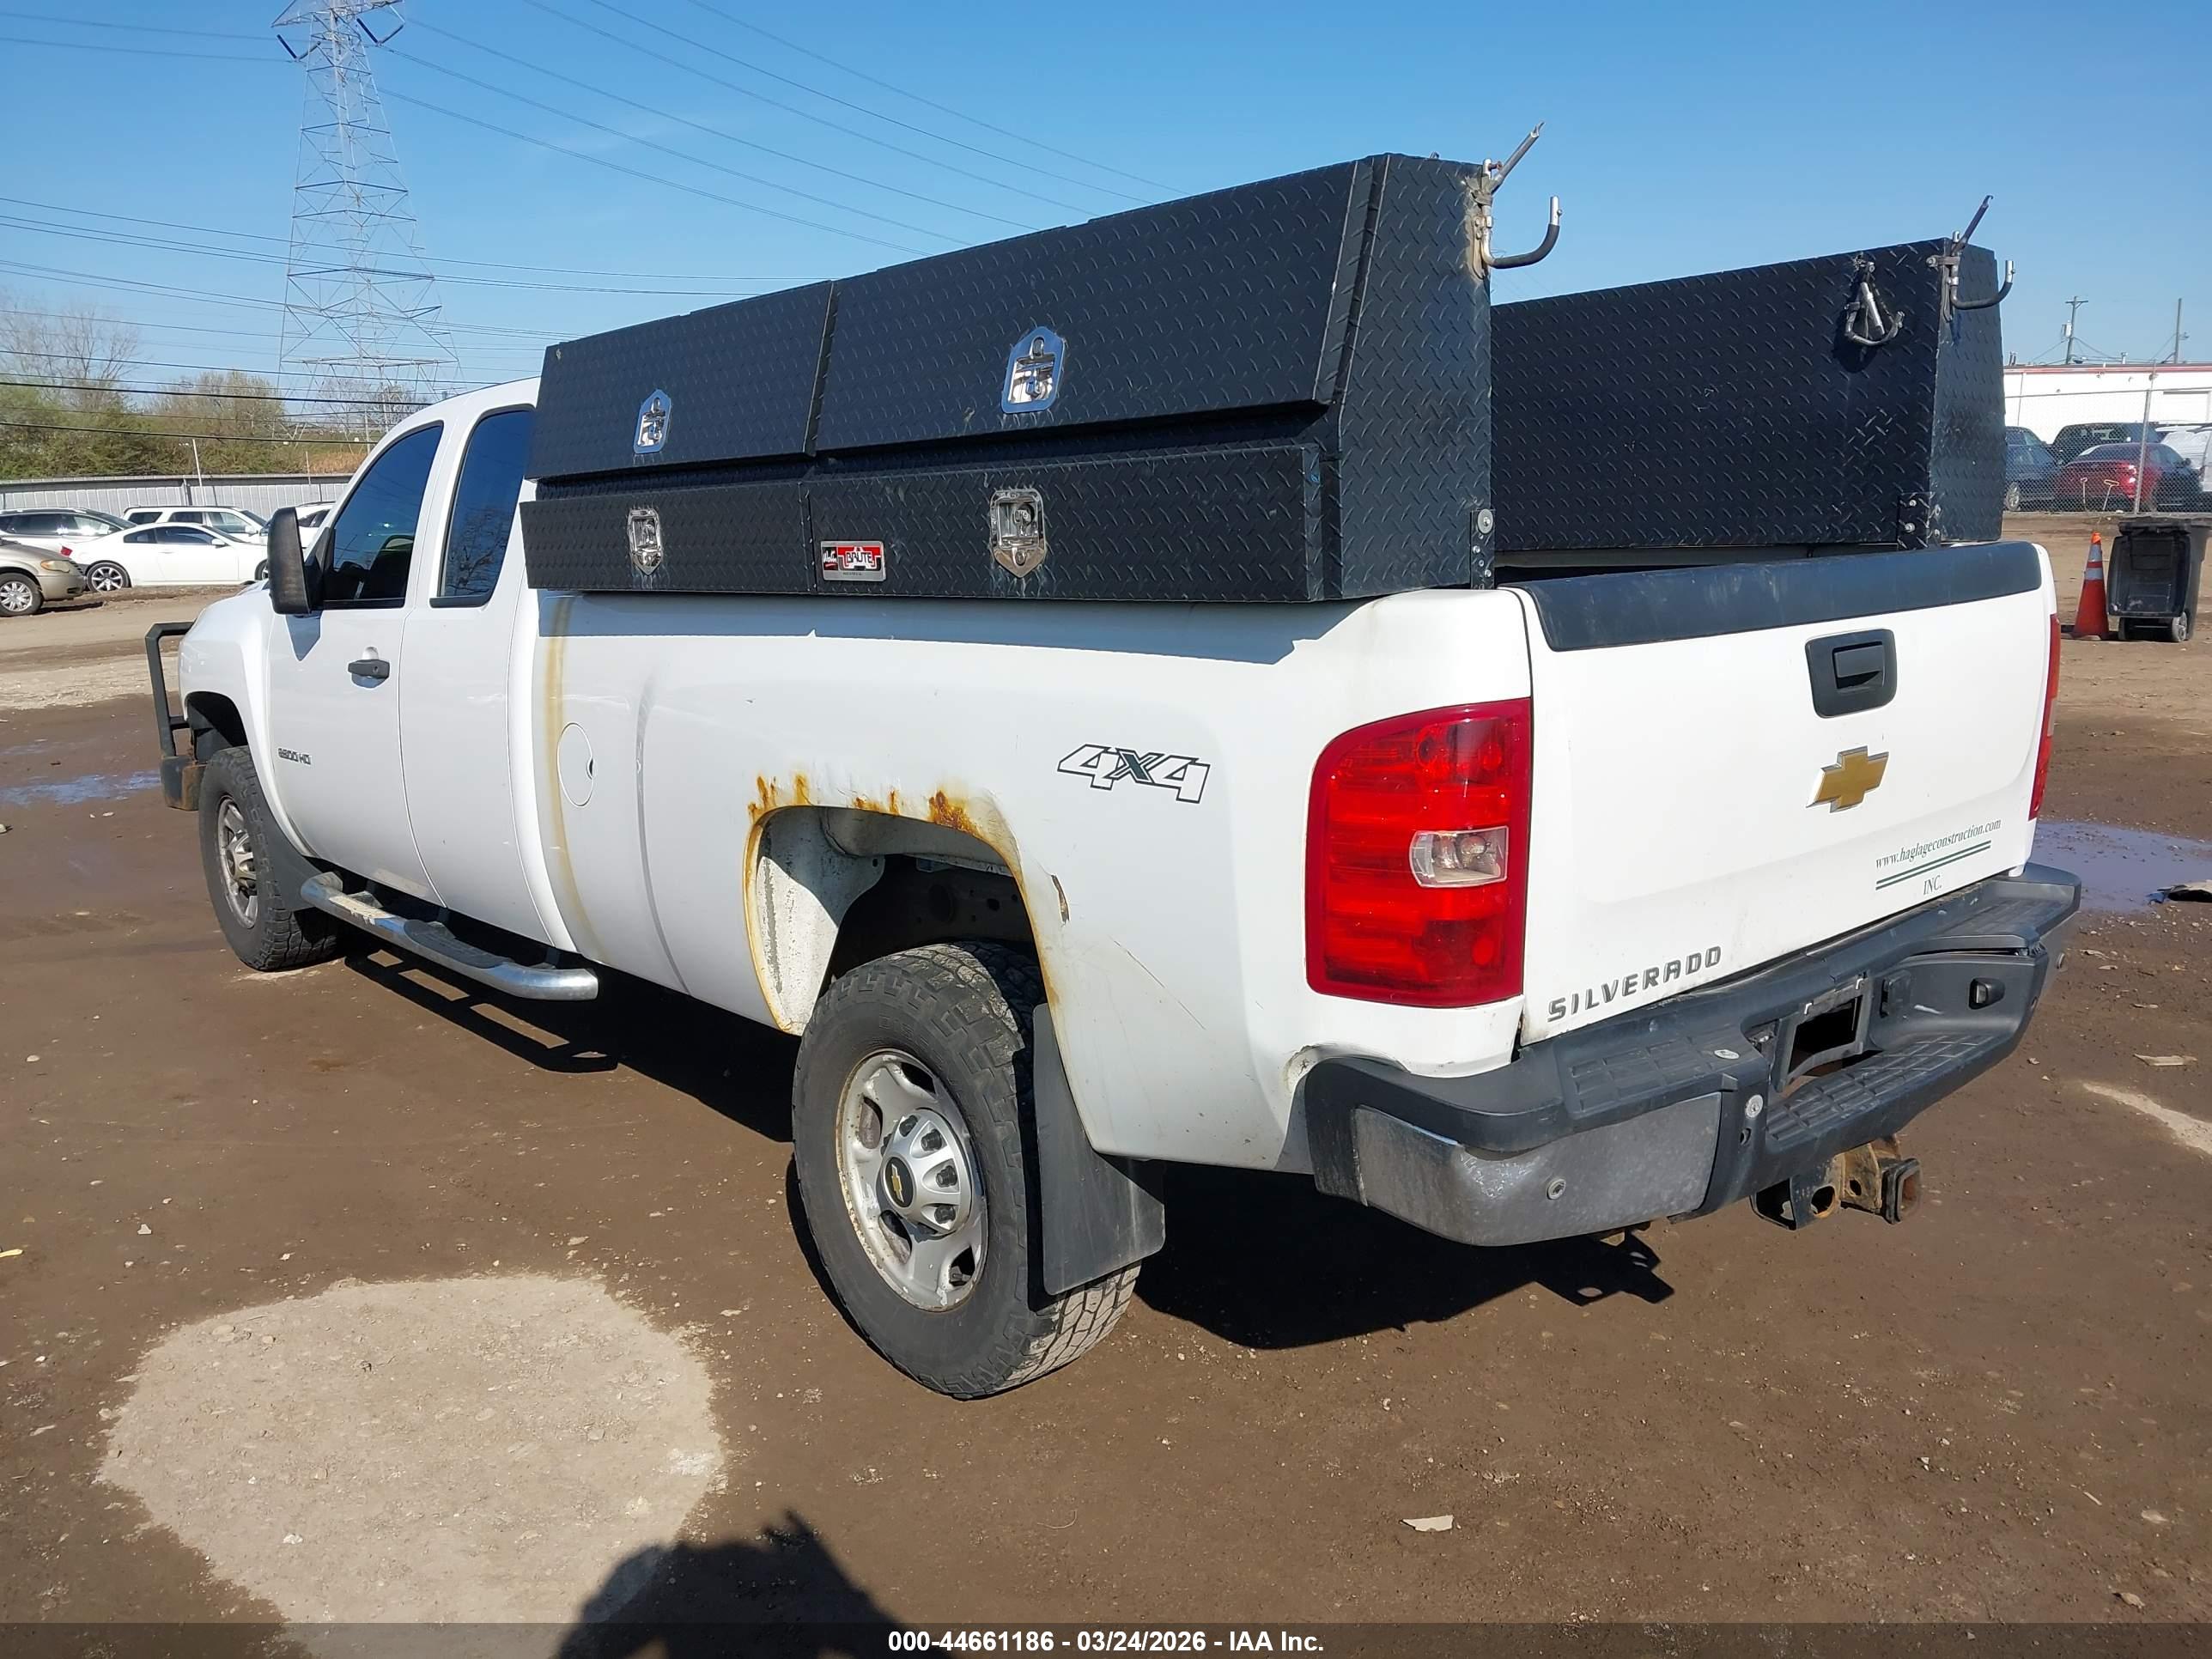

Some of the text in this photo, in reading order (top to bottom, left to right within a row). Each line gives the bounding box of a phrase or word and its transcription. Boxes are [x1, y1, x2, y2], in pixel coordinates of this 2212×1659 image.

[846, 551, 873, 564] BRUTE
[1875, 819, 2002, 868] www.haglageconstruction.com
[1923, 875, 1942, 896] INC.
[1547, 945, 1722, 1023] SILVERADO
